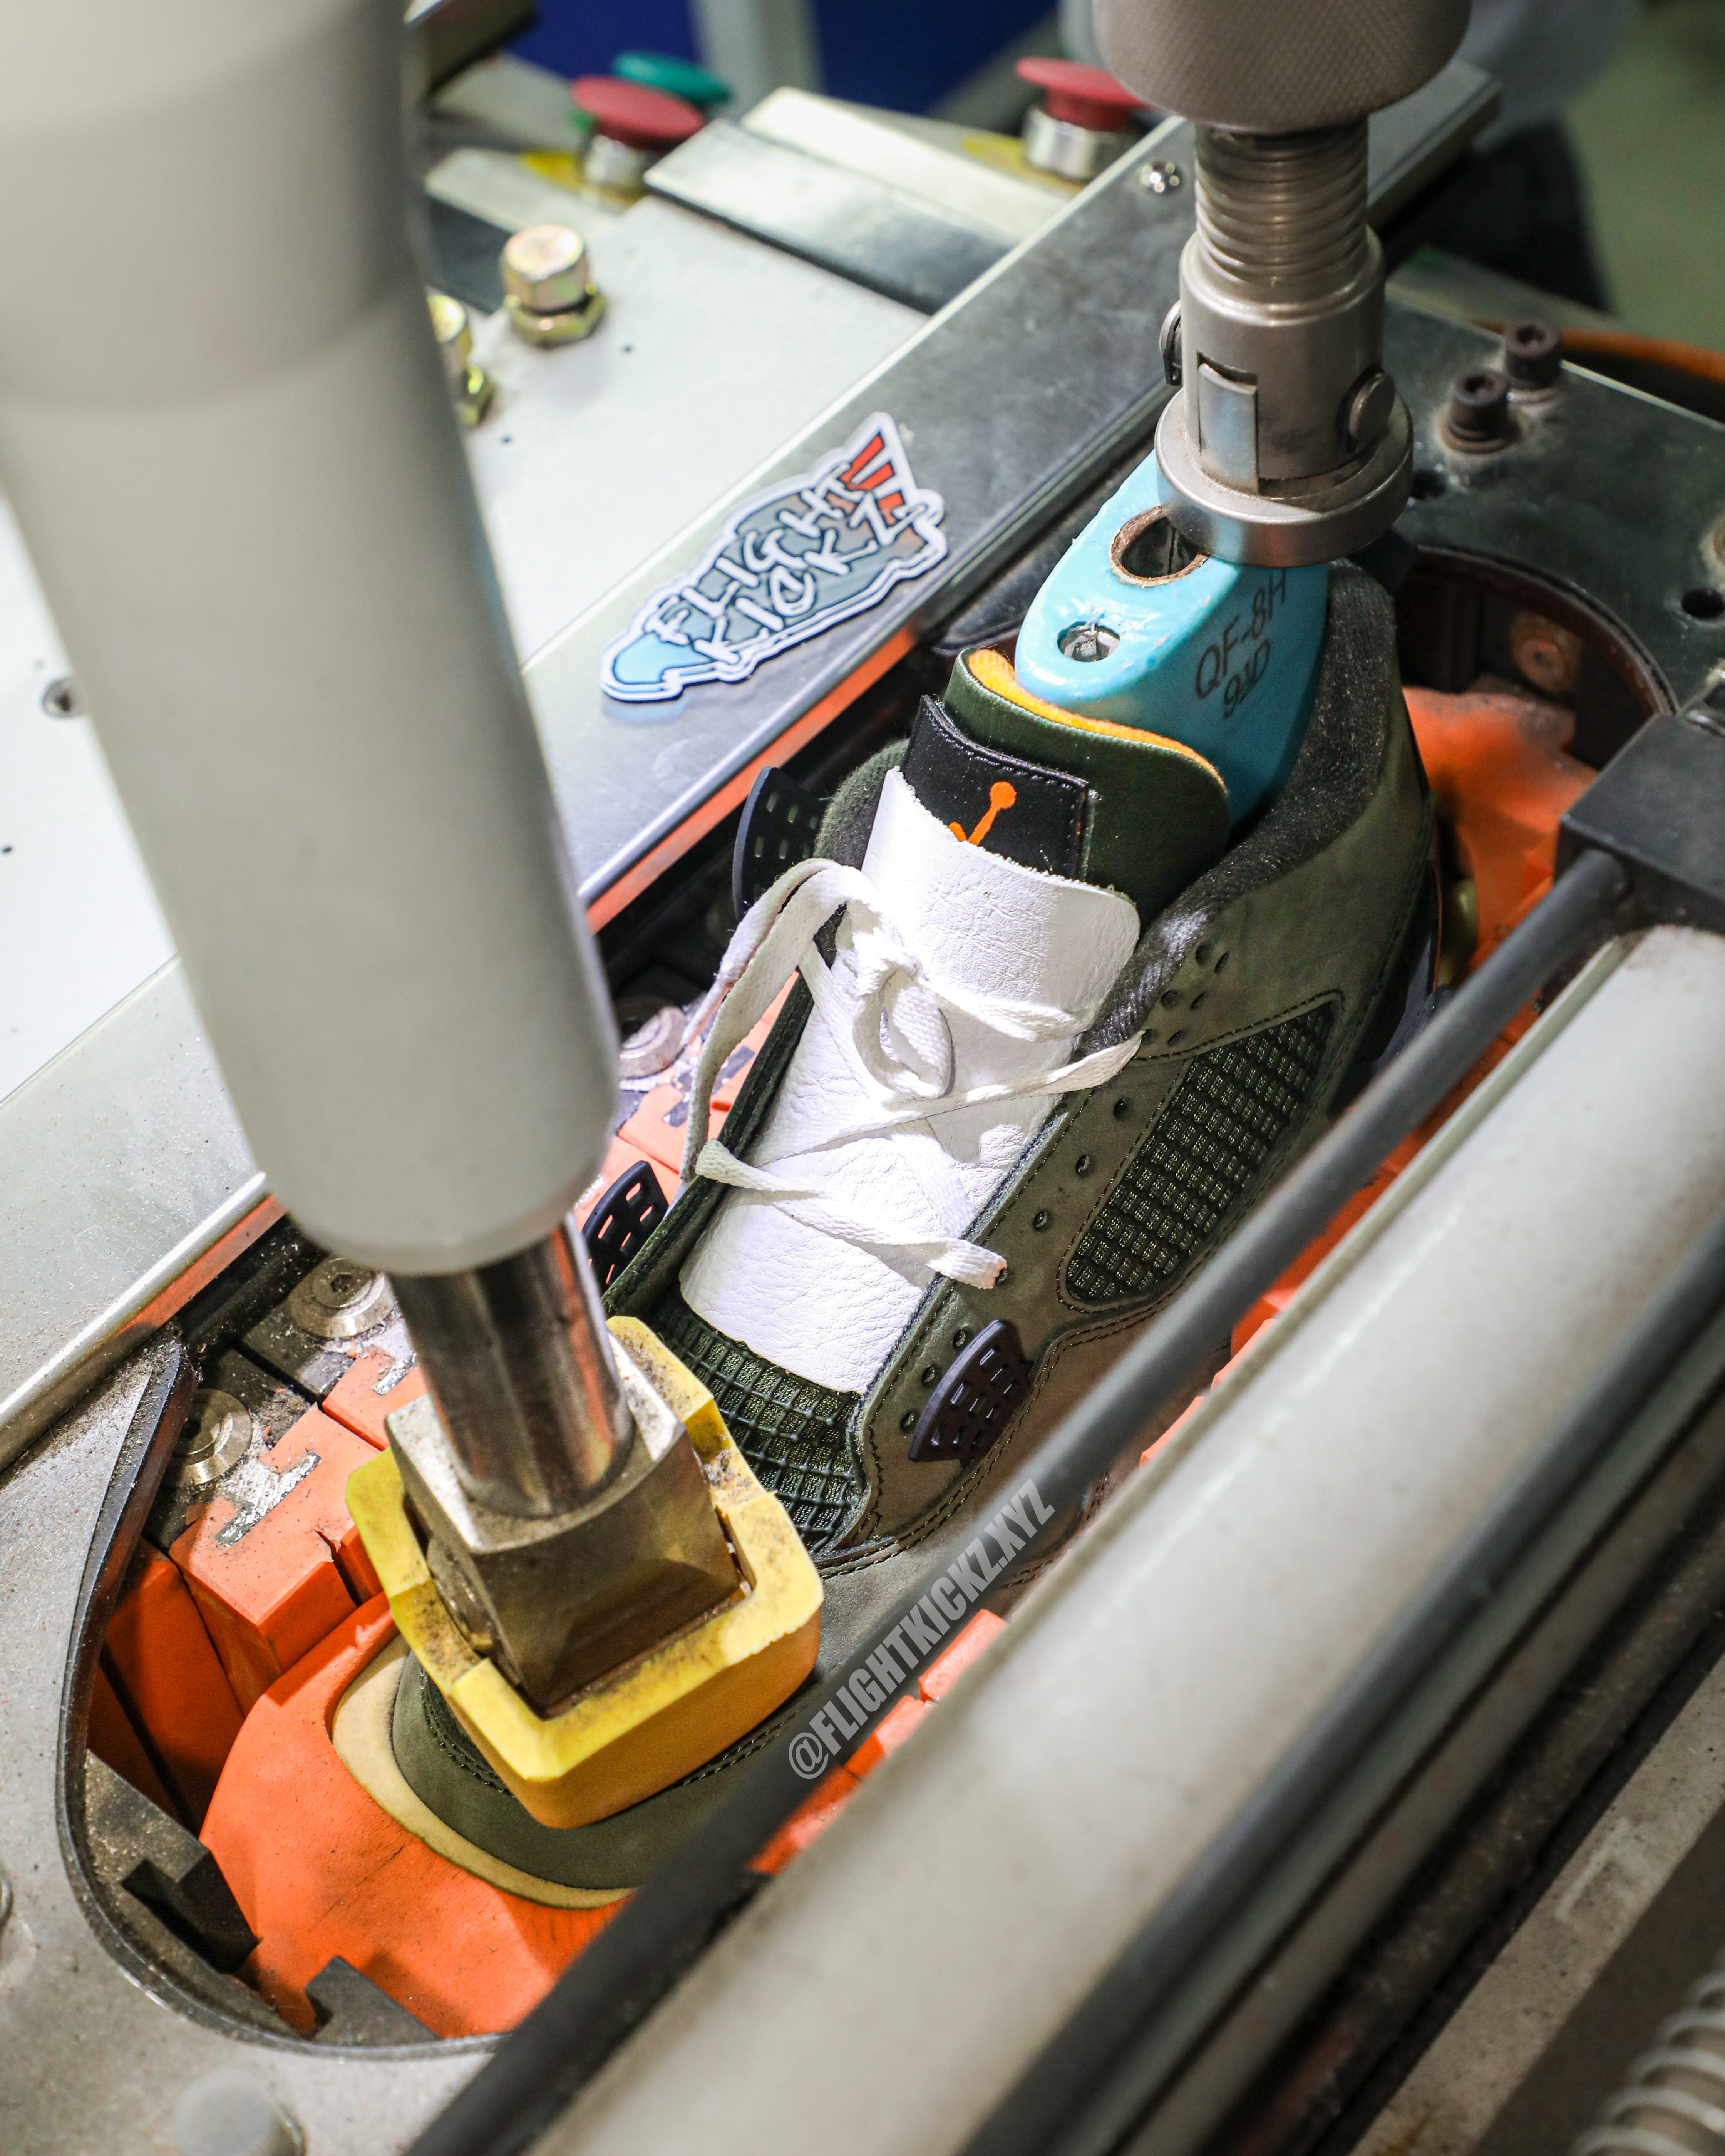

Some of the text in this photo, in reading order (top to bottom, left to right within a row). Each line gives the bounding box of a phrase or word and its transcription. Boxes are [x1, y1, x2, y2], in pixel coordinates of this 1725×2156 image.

[644, 463, 864, 645] FLIGHT
[693, 493, 927, 664] KICKZ
[1196, 569, 1287, 699] QF-8H
